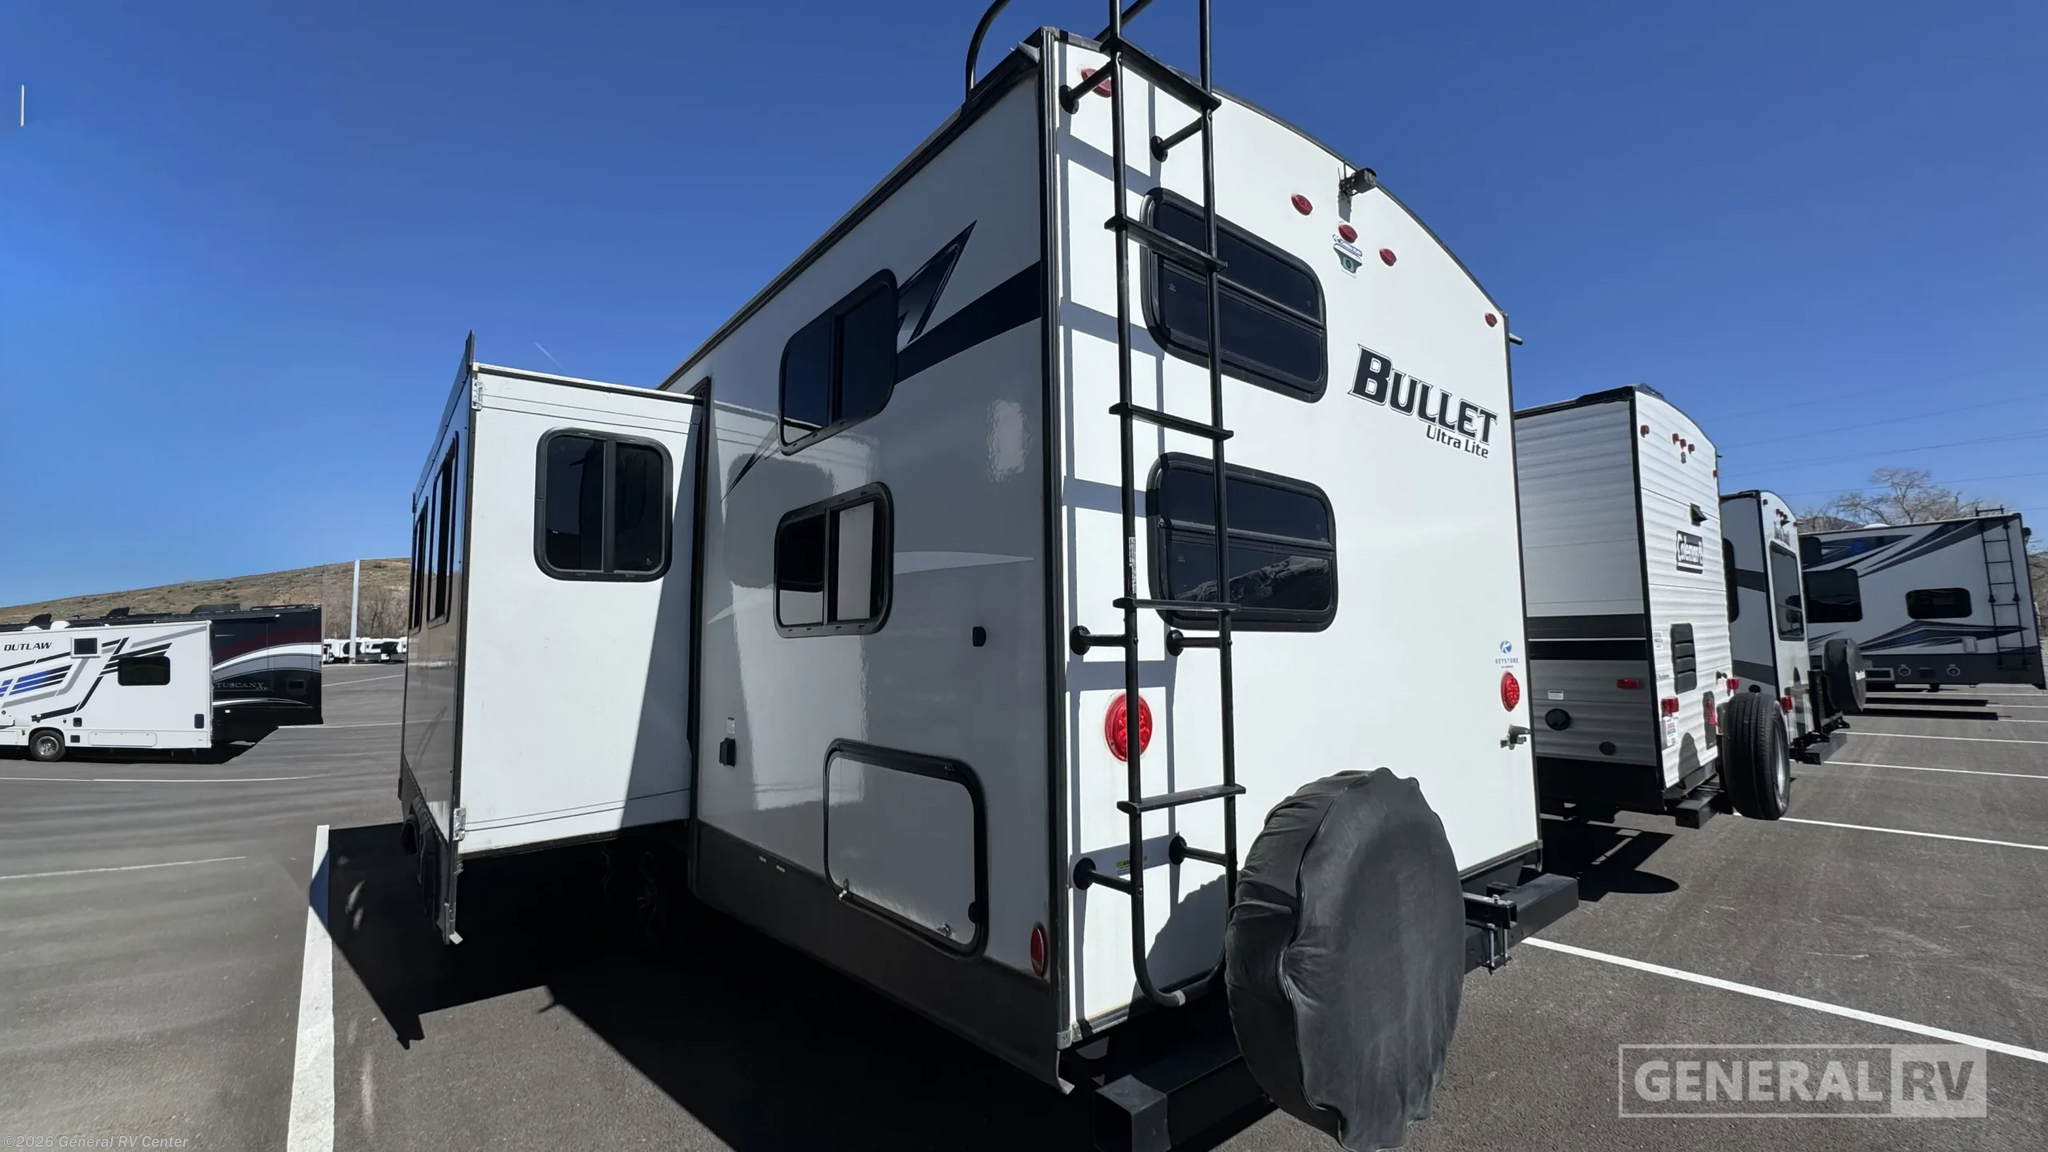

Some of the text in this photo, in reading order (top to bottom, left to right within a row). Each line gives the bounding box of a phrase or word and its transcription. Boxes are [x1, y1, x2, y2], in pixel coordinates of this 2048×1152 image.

[1348, 344, 1498, 445] BULLET
[1426, 425, 1489, 459] Ultra Lite
[4, 642, 52, 651] OUTLAW
